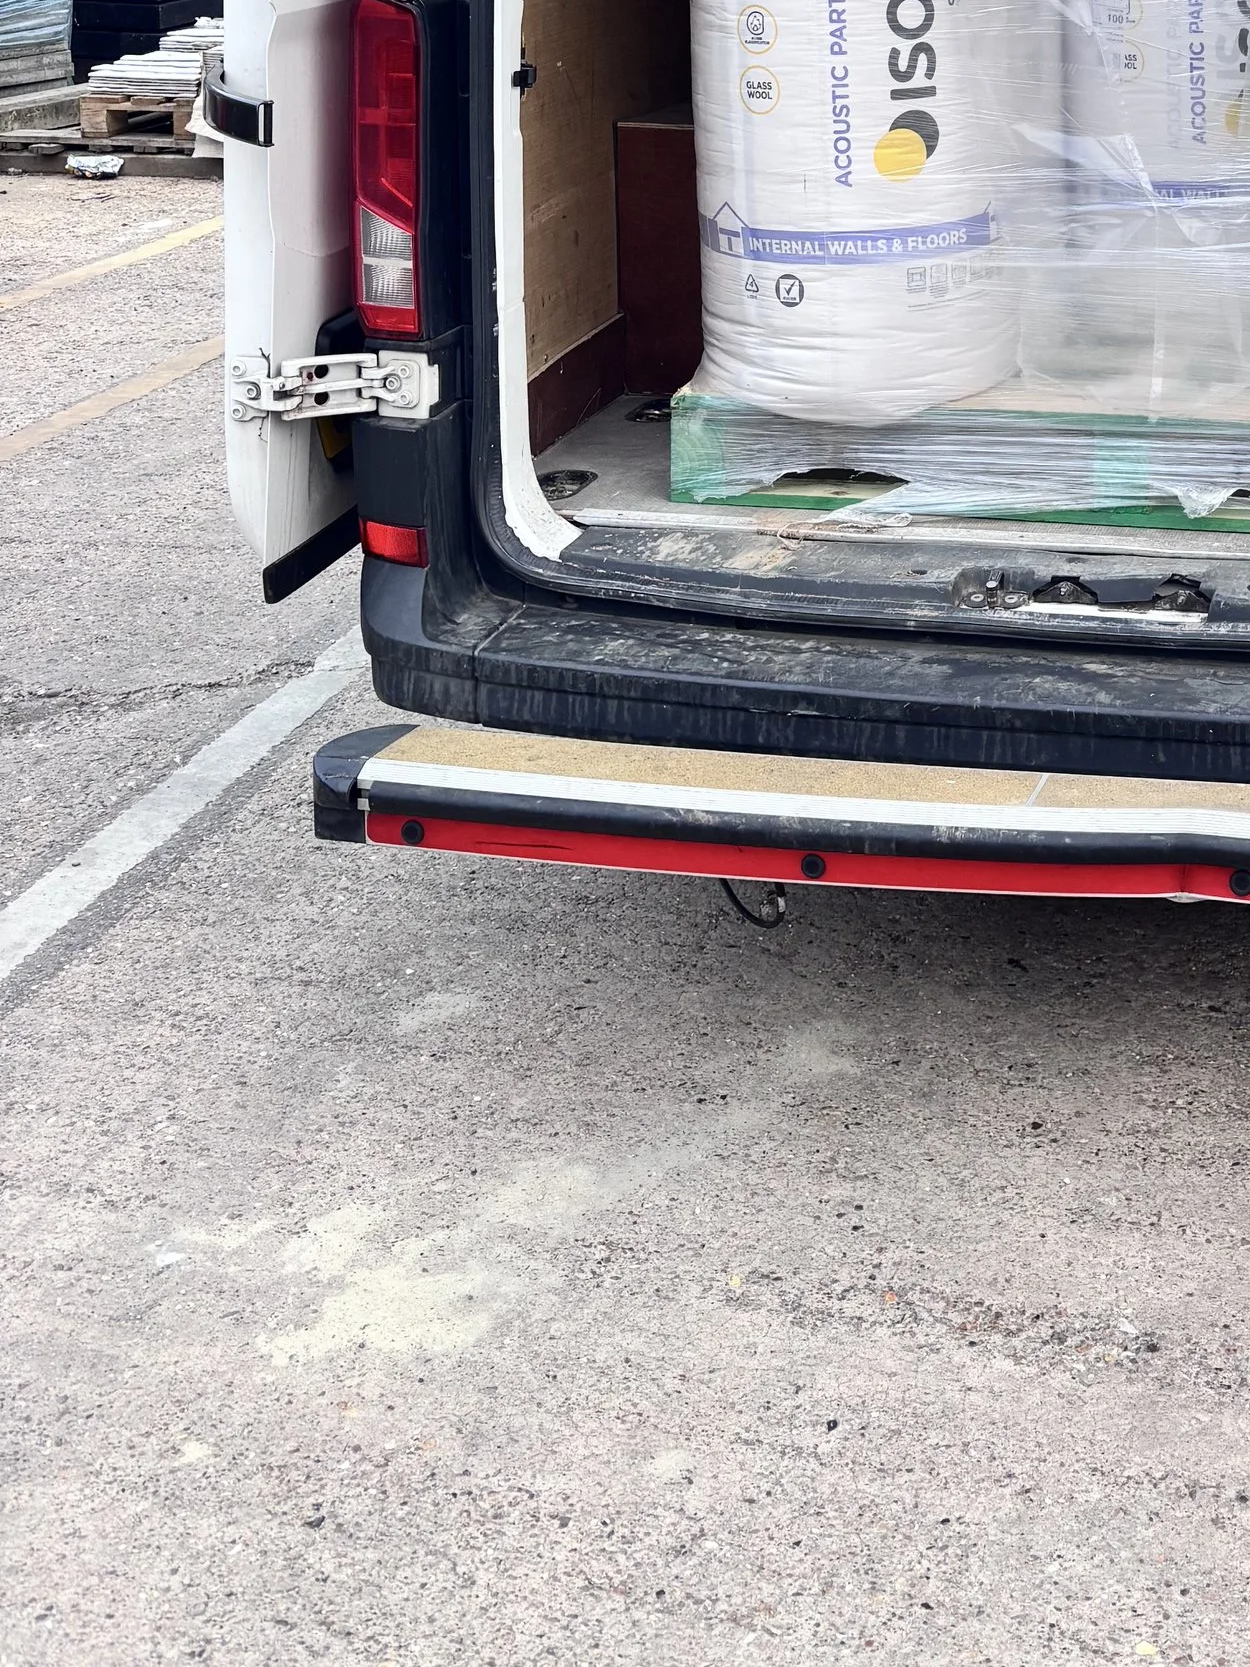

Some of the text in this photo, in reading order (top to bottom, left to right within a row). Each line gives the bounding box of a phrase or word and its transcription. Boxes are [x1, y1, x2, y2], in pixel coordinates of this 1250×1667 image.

[746, 80, 773, 90] GLASS
[747, 89, 773, 100] WOOL
[1189, 42, 1206, 144] ACOUSTIC
[831, 65, 853, 188] ACOUSTIC
[749, 228, 968, 256] INTERNAL WALLS & FLOORS
